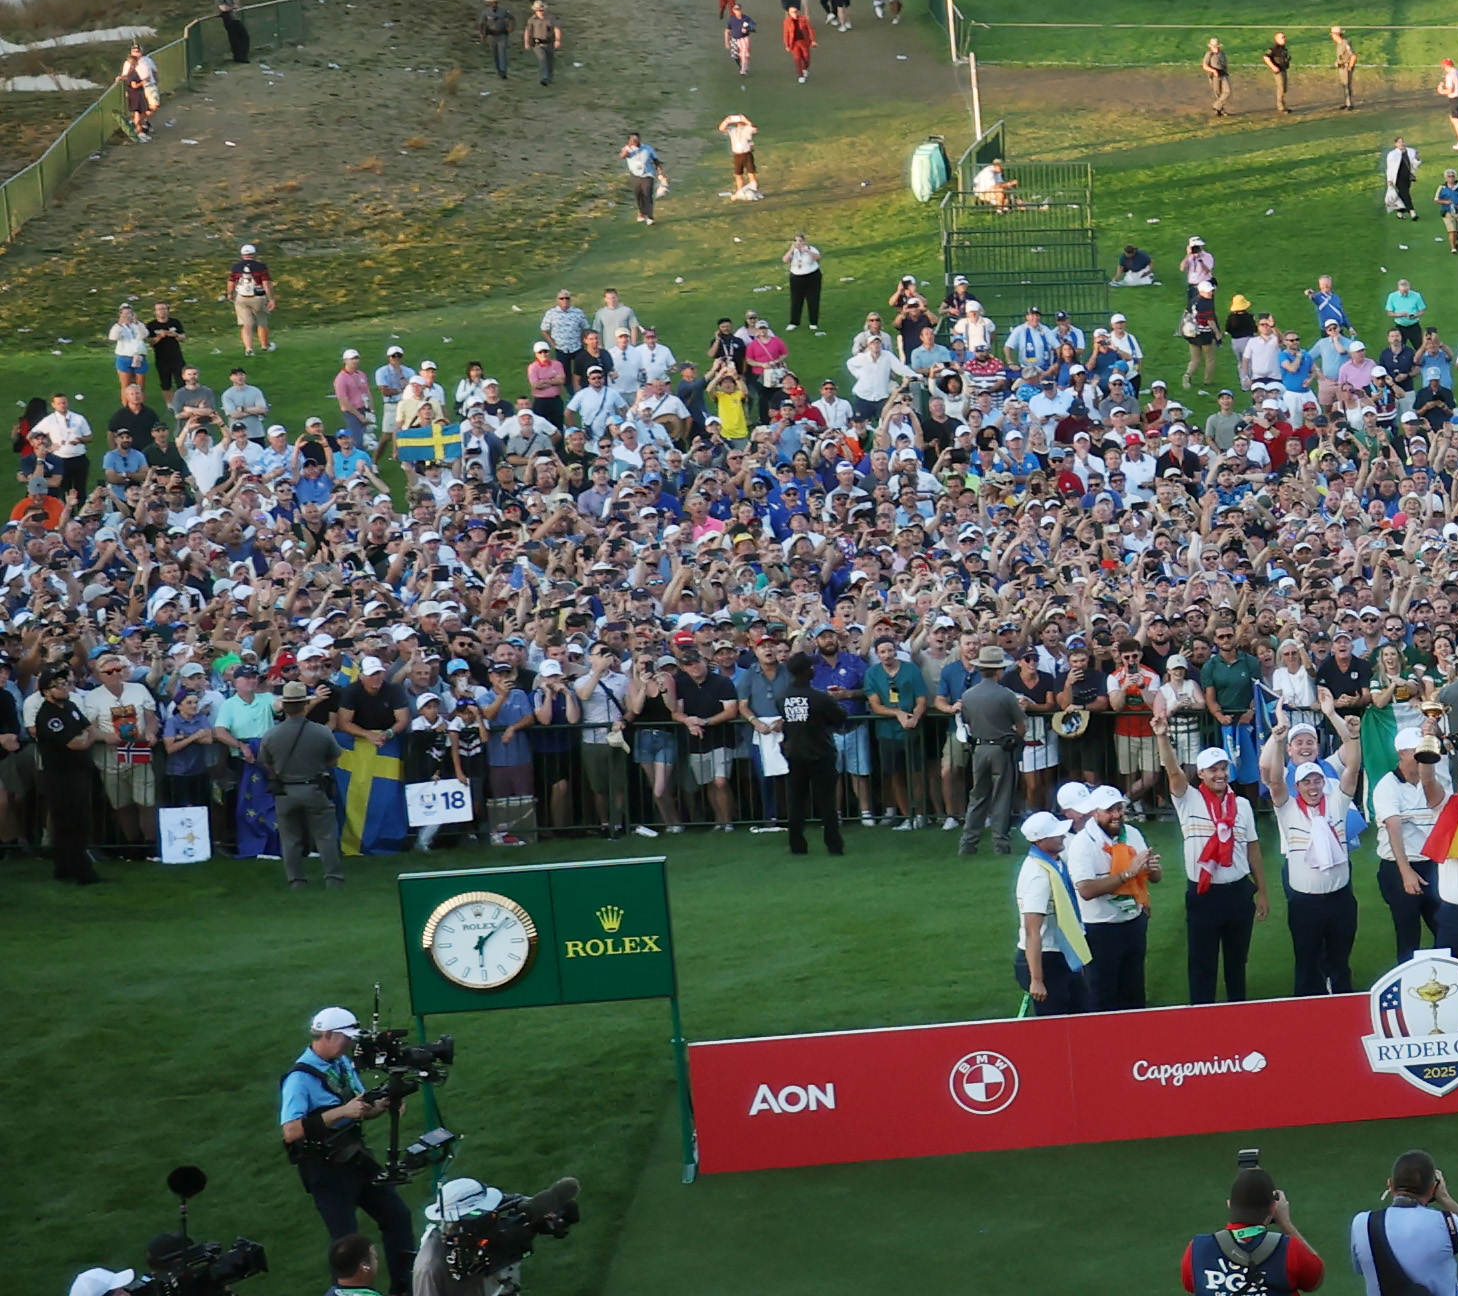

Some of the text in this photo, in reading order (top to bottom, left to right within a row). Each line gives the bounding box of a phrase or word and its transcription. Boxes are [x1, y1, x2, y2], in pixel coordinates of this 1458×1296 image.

[784, 697, 809, 707] APEX
[440, 790, 466, 810] 18
[462, 922, 497, 931] ROLEX
[565, 935, 662, 958] ROLEX
[1376, 1040, 1451, 1062] RYDER
[959, 1054, 1008, 1074] BMW
[1132, 1053, 1243, 1087] Capgemini
[1423, 1066, 1457, 1080] 2025
[748, 1082, 836, 1116] AON
